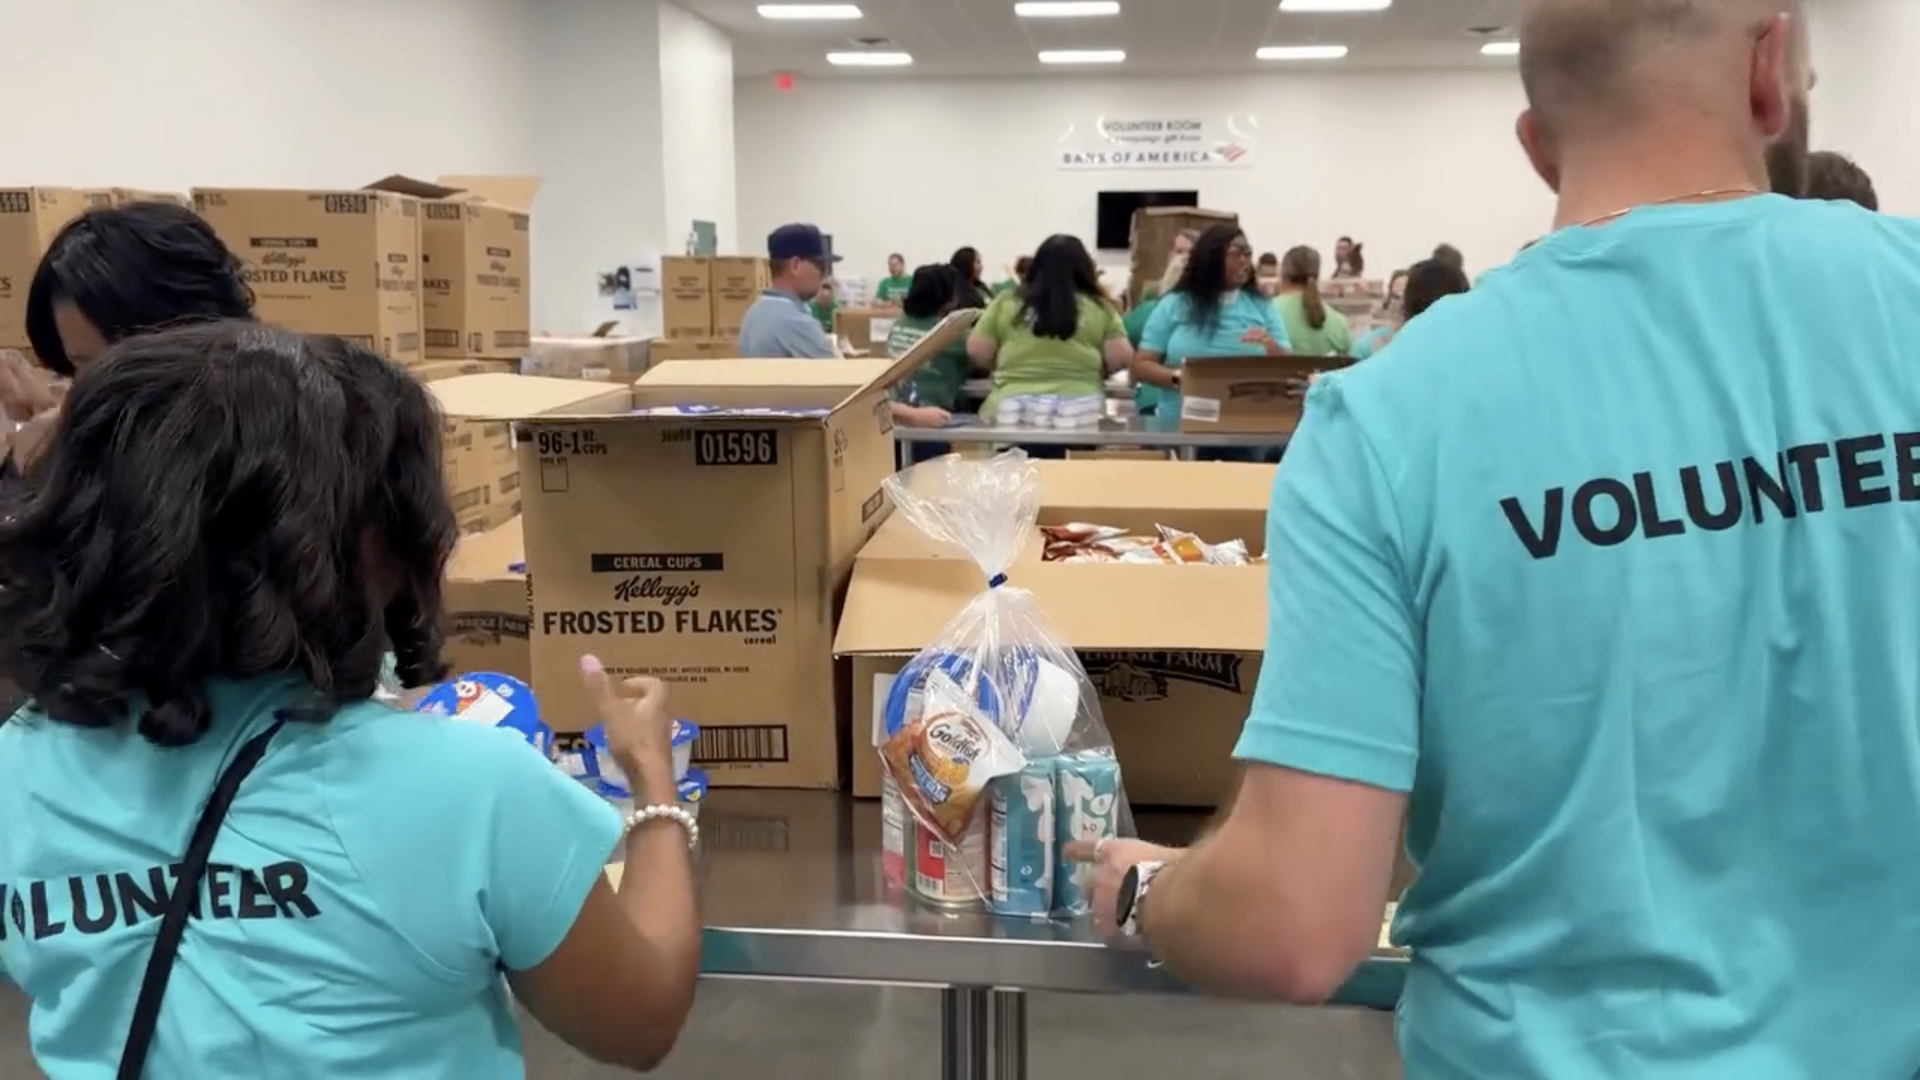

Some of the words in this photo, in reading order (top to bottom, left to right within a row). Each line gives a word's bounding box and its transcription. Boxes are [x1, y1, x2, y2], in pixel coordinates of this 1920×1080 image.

[1105, 120, 1164, 132] VOLUNTEER
[1166, 120, 1202, 131] ROOM
[1063, 152, 1107, 164] BANK
[1111, 152, 1132, 164] OF
[1135, 151, 1211, 163] AMERICA
[242, 270, 288, 284] OSTED
[293, 270, 346, 284] FLAKES
[423, 278, 450, 290] AKES
[538, 431, 582, 455] 96-1
[700, 432, 772, 464] 01596
[613, 557, 662, 569] CEREAL
[666, 556, 702, 569] CUPS
[614, 575, 701, 606] Kellogg's
[543, 610, 665, 635] FROSTED
[675, 609, 778, 634] FLAKES
[743, 635, 777, 646] cereal
[1163, 651, 1224, 674] FARM
[929, 723, 983, 763] Goldfish
[0, 861, 322, 941] OLUNEER
